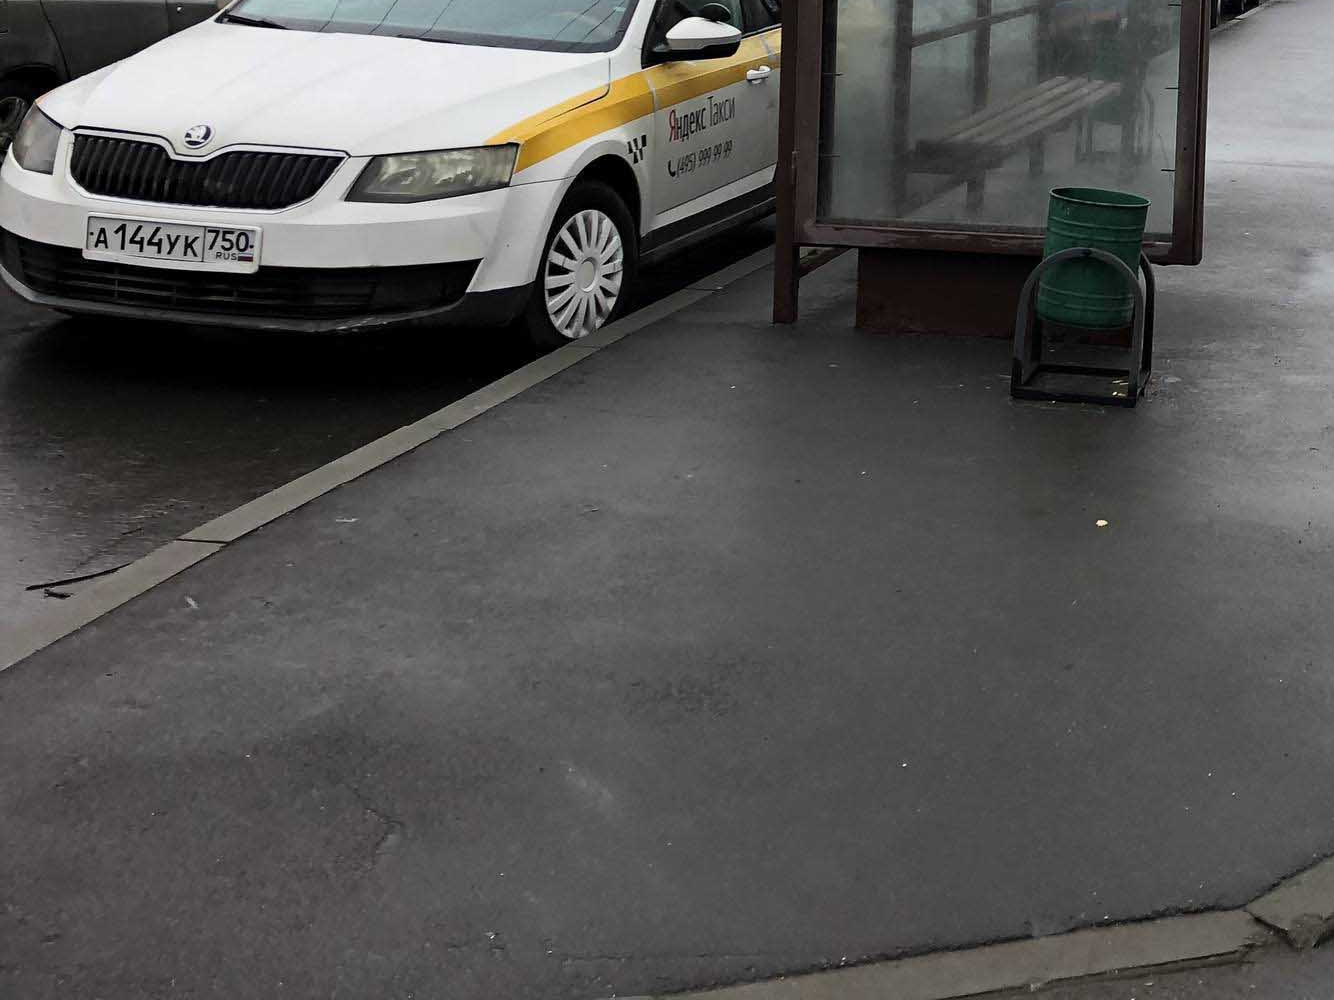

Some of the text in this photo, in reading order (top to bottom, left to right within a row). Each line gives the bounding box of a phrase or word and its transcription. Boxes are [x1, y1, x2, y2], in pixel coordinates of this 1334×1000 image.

[668, 96, 736, 142] Яндекс Такси
[207, 229, 249, 252] 750
[215, 251, 237, 261] RUS
